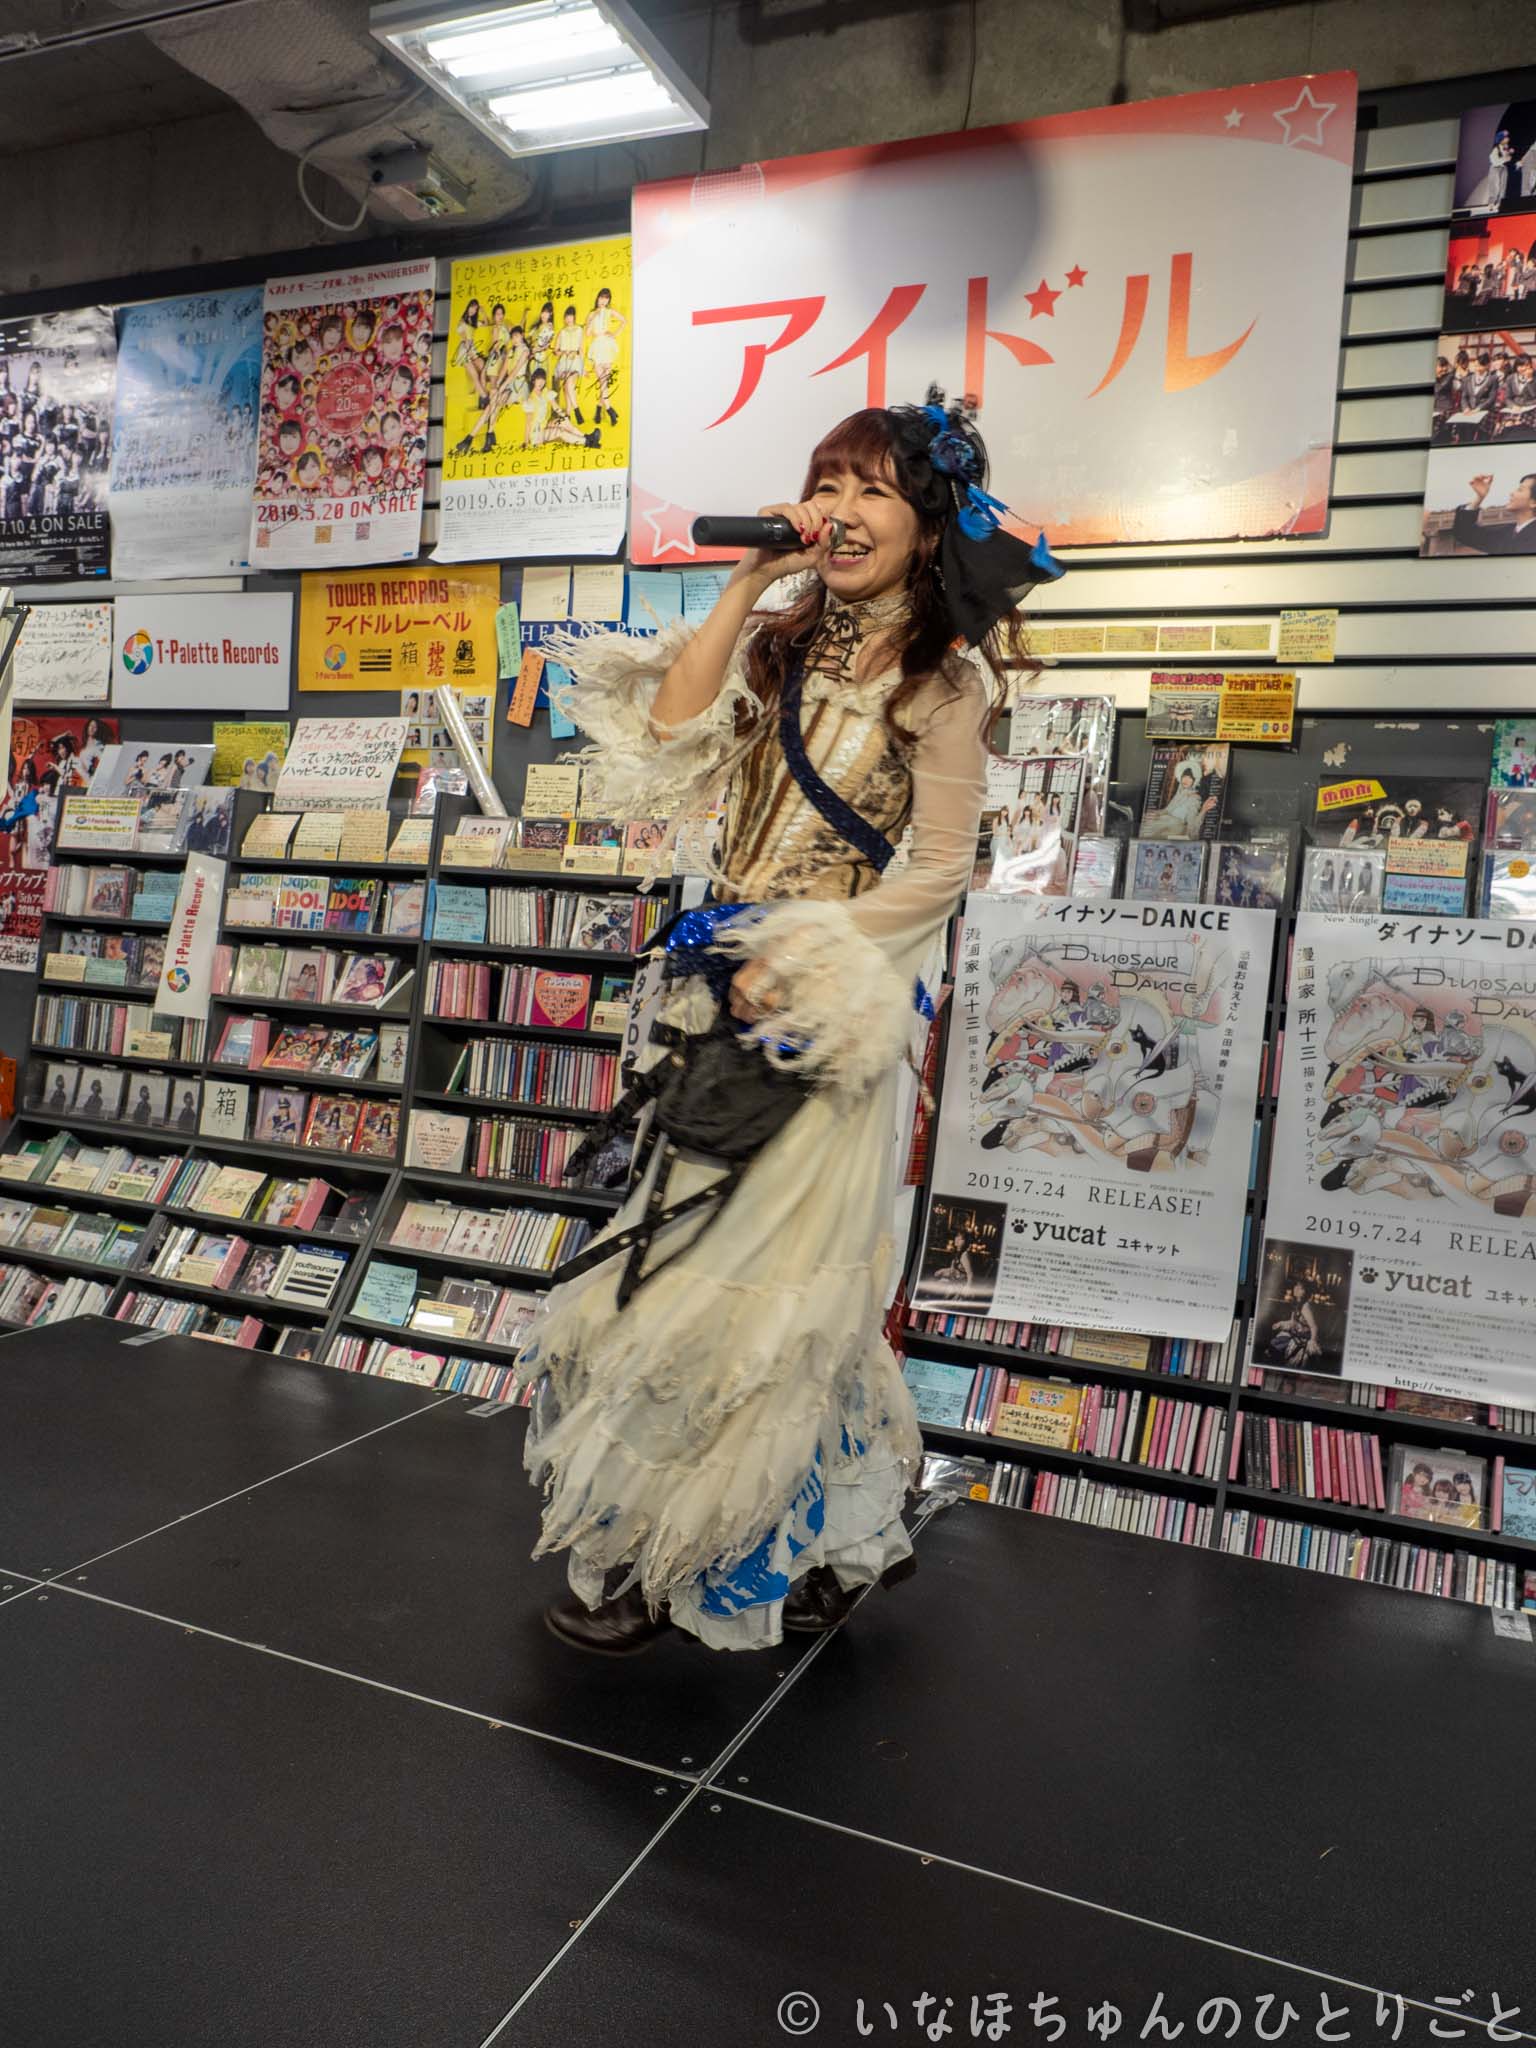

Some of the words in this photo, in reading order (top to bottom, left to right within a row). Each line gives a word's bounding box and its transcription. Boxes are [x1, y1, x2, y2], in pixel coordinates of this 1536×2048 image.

[367, 263, 431, 282] ANNIVERSARY
[692, 252, 1257, 430] アイドル
[447, 451, 625, 480] Juice=Juice
[488, 479, 521, 490] New
[524, 474, 577, 490] Single
[350, 499, 373, 518] ON
[378, 493, 418, 515] SALE
[445, 490, 526, 512] 2019.6.5
[41, 517, 63, 533] ON
[67, 514, 103, 531] SALE
[326, 584, 377, 608] TOWER
[381, 579, 450, 605] RECORDS
[325, 611, 472, 636] アイドルレーベル
[156, 640, 219, 665] T-Palette
[222, 639, 280, 665] Records
[400, 641, 419, 667] 箱
[186, 876, 205, 917] Records
[280, 890, 325, 910] IDOL
[329, 892, 371, 911] IDOL
[278, 909, 325, 929] FILE
[1034, 903, 1231, 933] ダイナソーDANCE
[1323, 915, 1346, 923] New
[1350, 915, 1379, 926] Single
[1297, 946, 1316, 1000] 漫画家
[963, 982, 981, 1031] 所十三
[1298, 1007, 1317, 1061] 所十三
[216, 1087, 237, 1116] 箱
[967, 1172, 1066, 1200] 2019.7.24
[1088, 1186, 1203, 1218] RELEASE!
[1032, 1219, 1107, 1248] yucat
[1116, 1237, 1181, 1258] ユキャット
[1305, 1215, 1422, 1246] 2019.7.24
[1384, 1269, 1473, 1299] yucat
